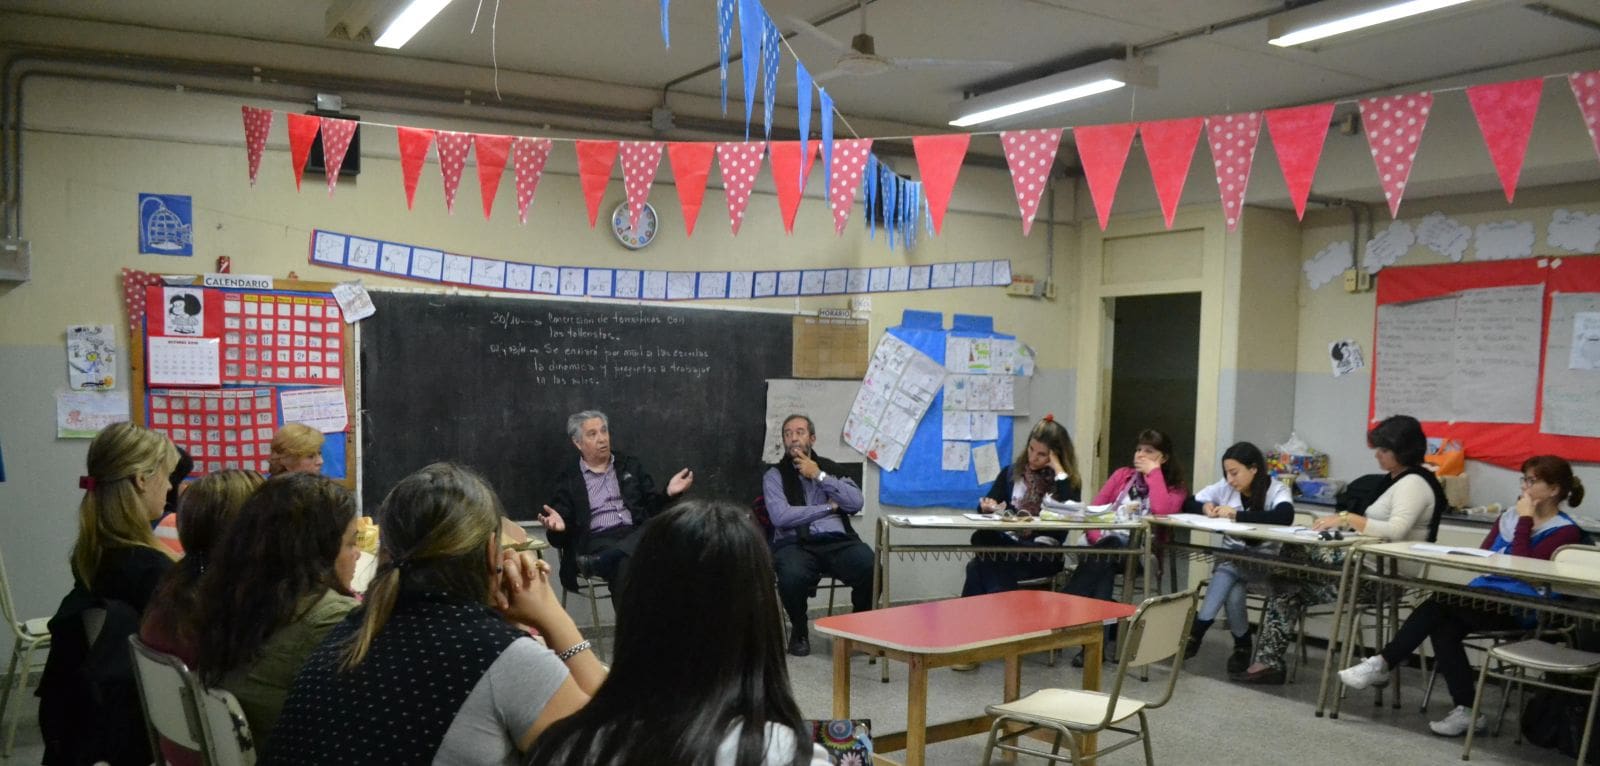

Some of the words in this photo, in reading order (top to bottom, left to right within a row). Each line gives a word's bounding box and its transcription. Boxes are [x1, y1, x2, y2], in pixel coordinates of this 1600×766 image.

[205, 277, 269, 289] CALENDARIO
[819, 309, 850, 318] HORARIO
[549, 326, 565, 338] los
[543, 343, 560, 354] Se
[604, 349, 620, 363] por
[533, 356, 545, 372] la
[670, 360, 712, 379] trabajar
